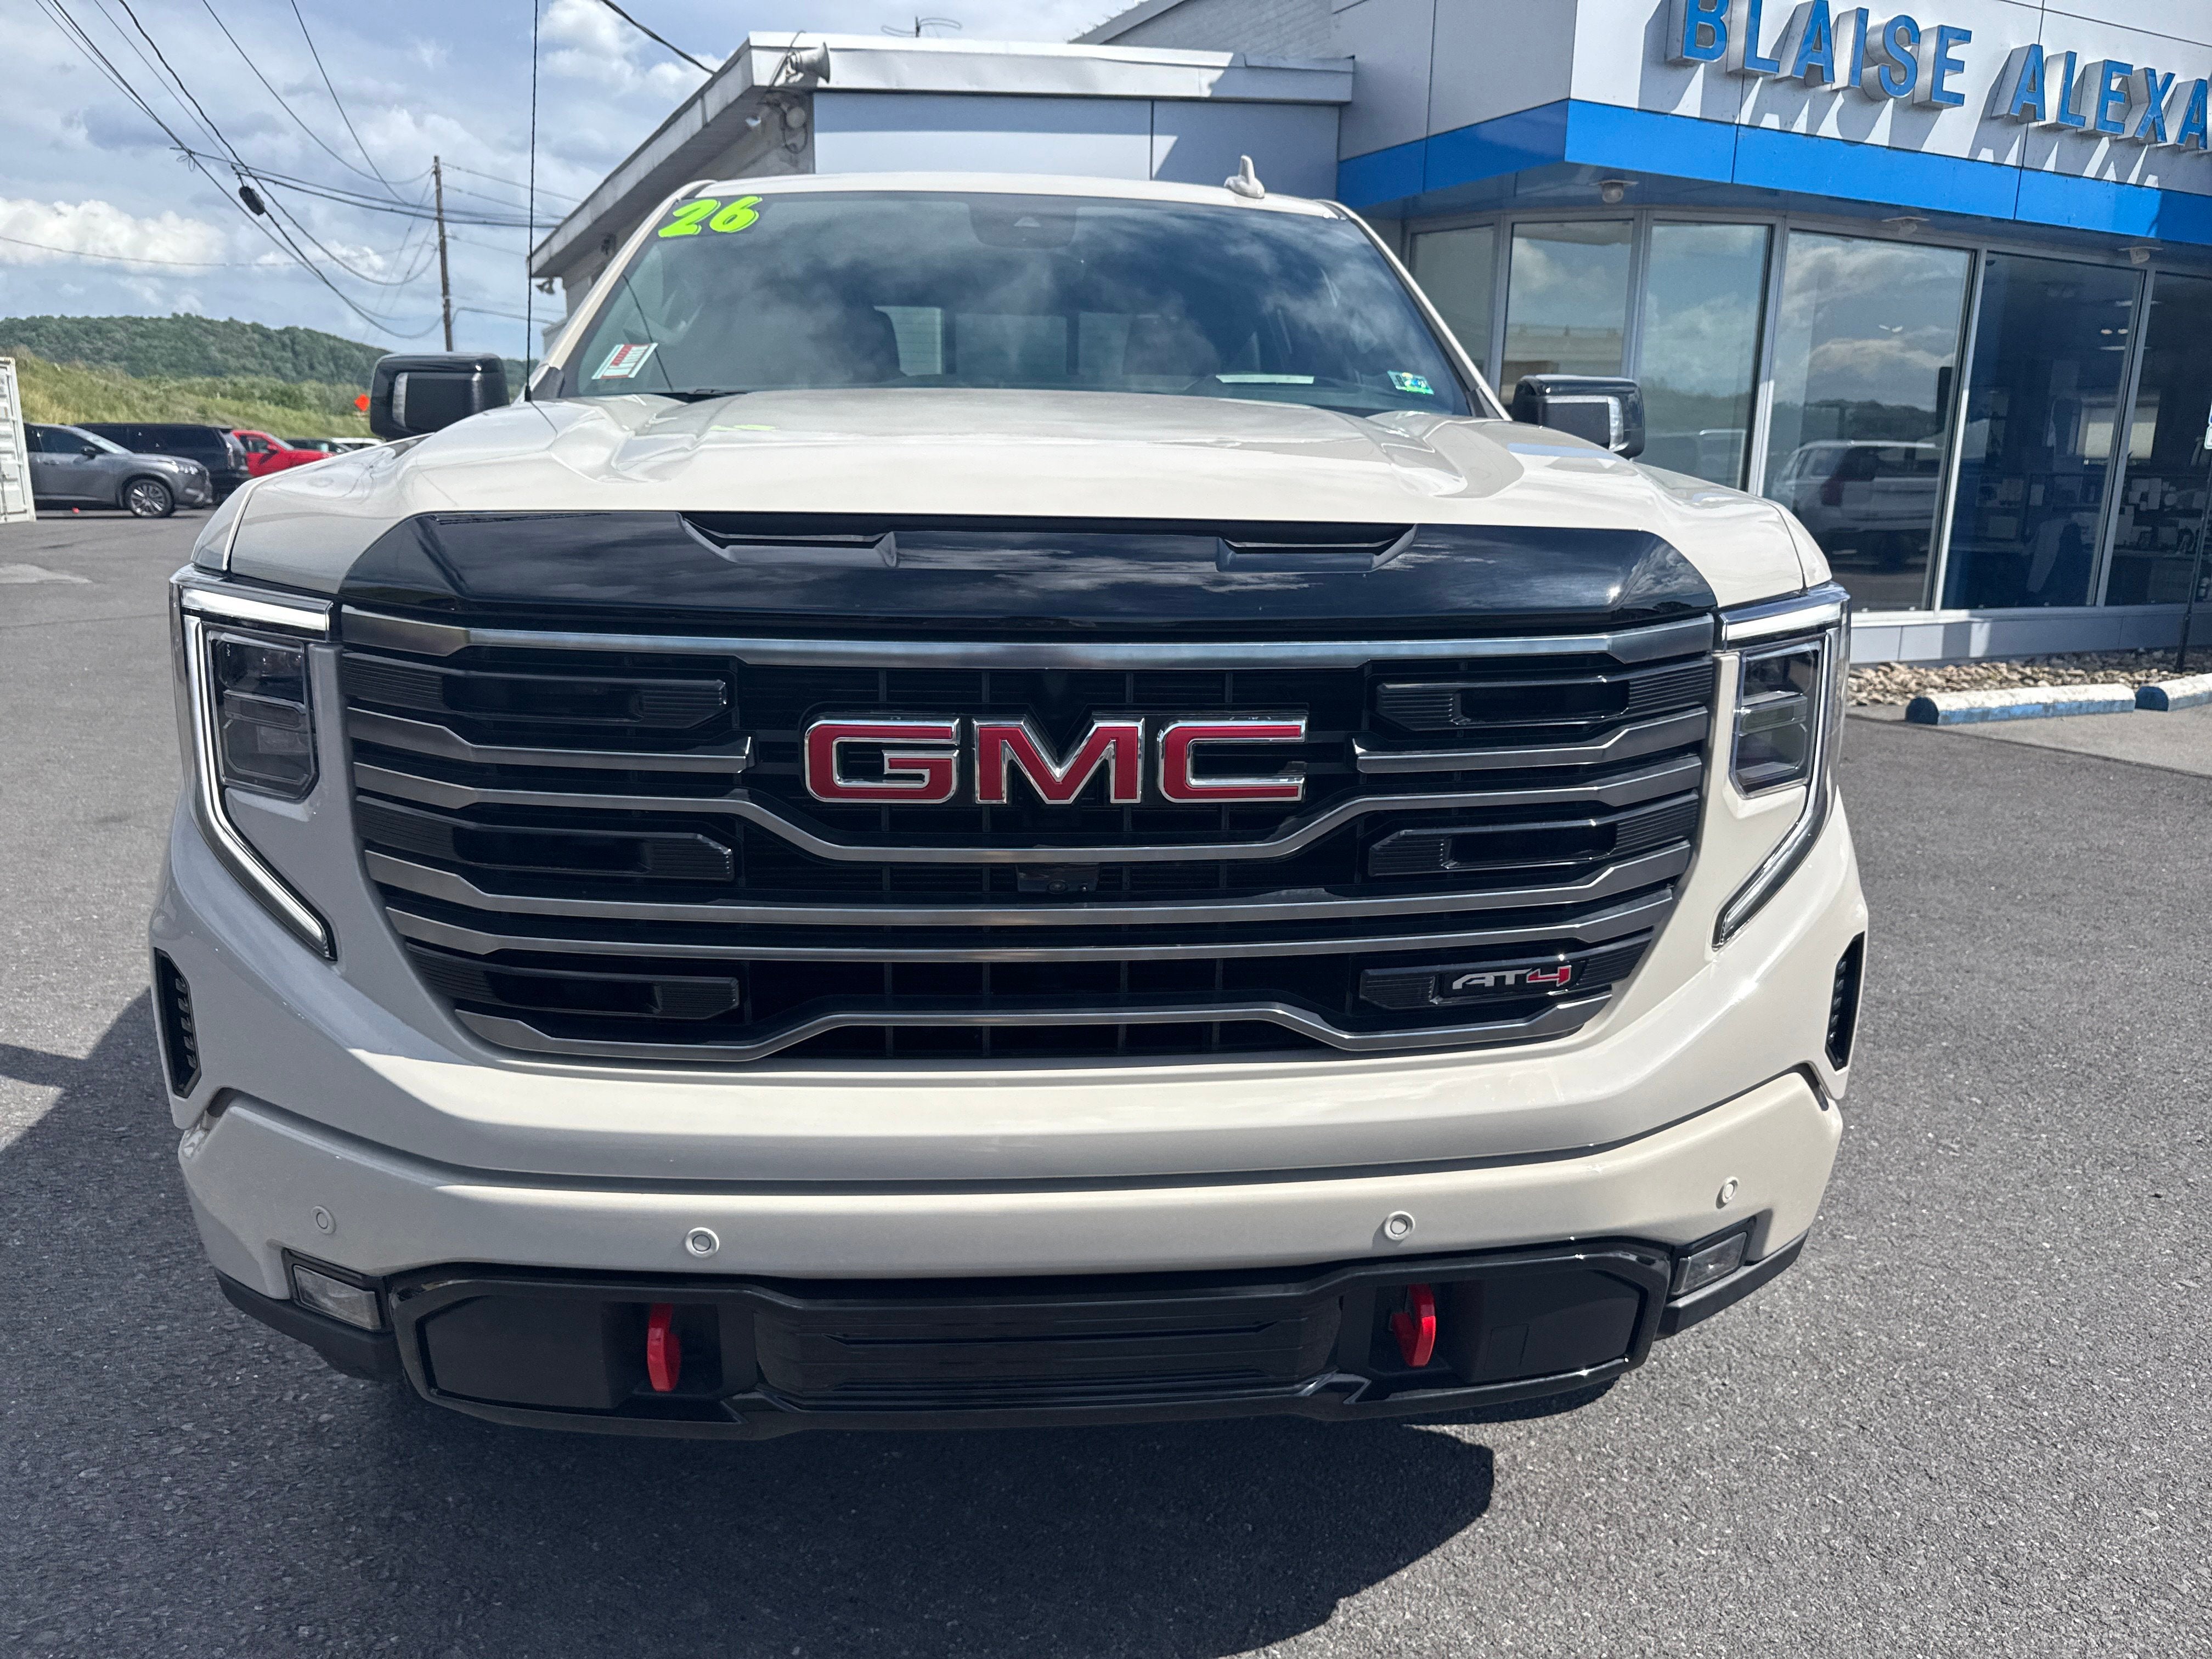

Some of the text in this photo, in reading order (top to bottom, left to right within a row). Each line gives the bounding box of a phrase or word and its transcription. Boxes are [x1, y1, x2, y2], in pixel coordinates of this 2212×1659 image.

[1683, 0, 2208, 150] BLAISE ALEXA
[658, 196, 763, 238] 26
[804, 716, 1306, 804] GMC
[1452, 964, 1571, 988] AT4
